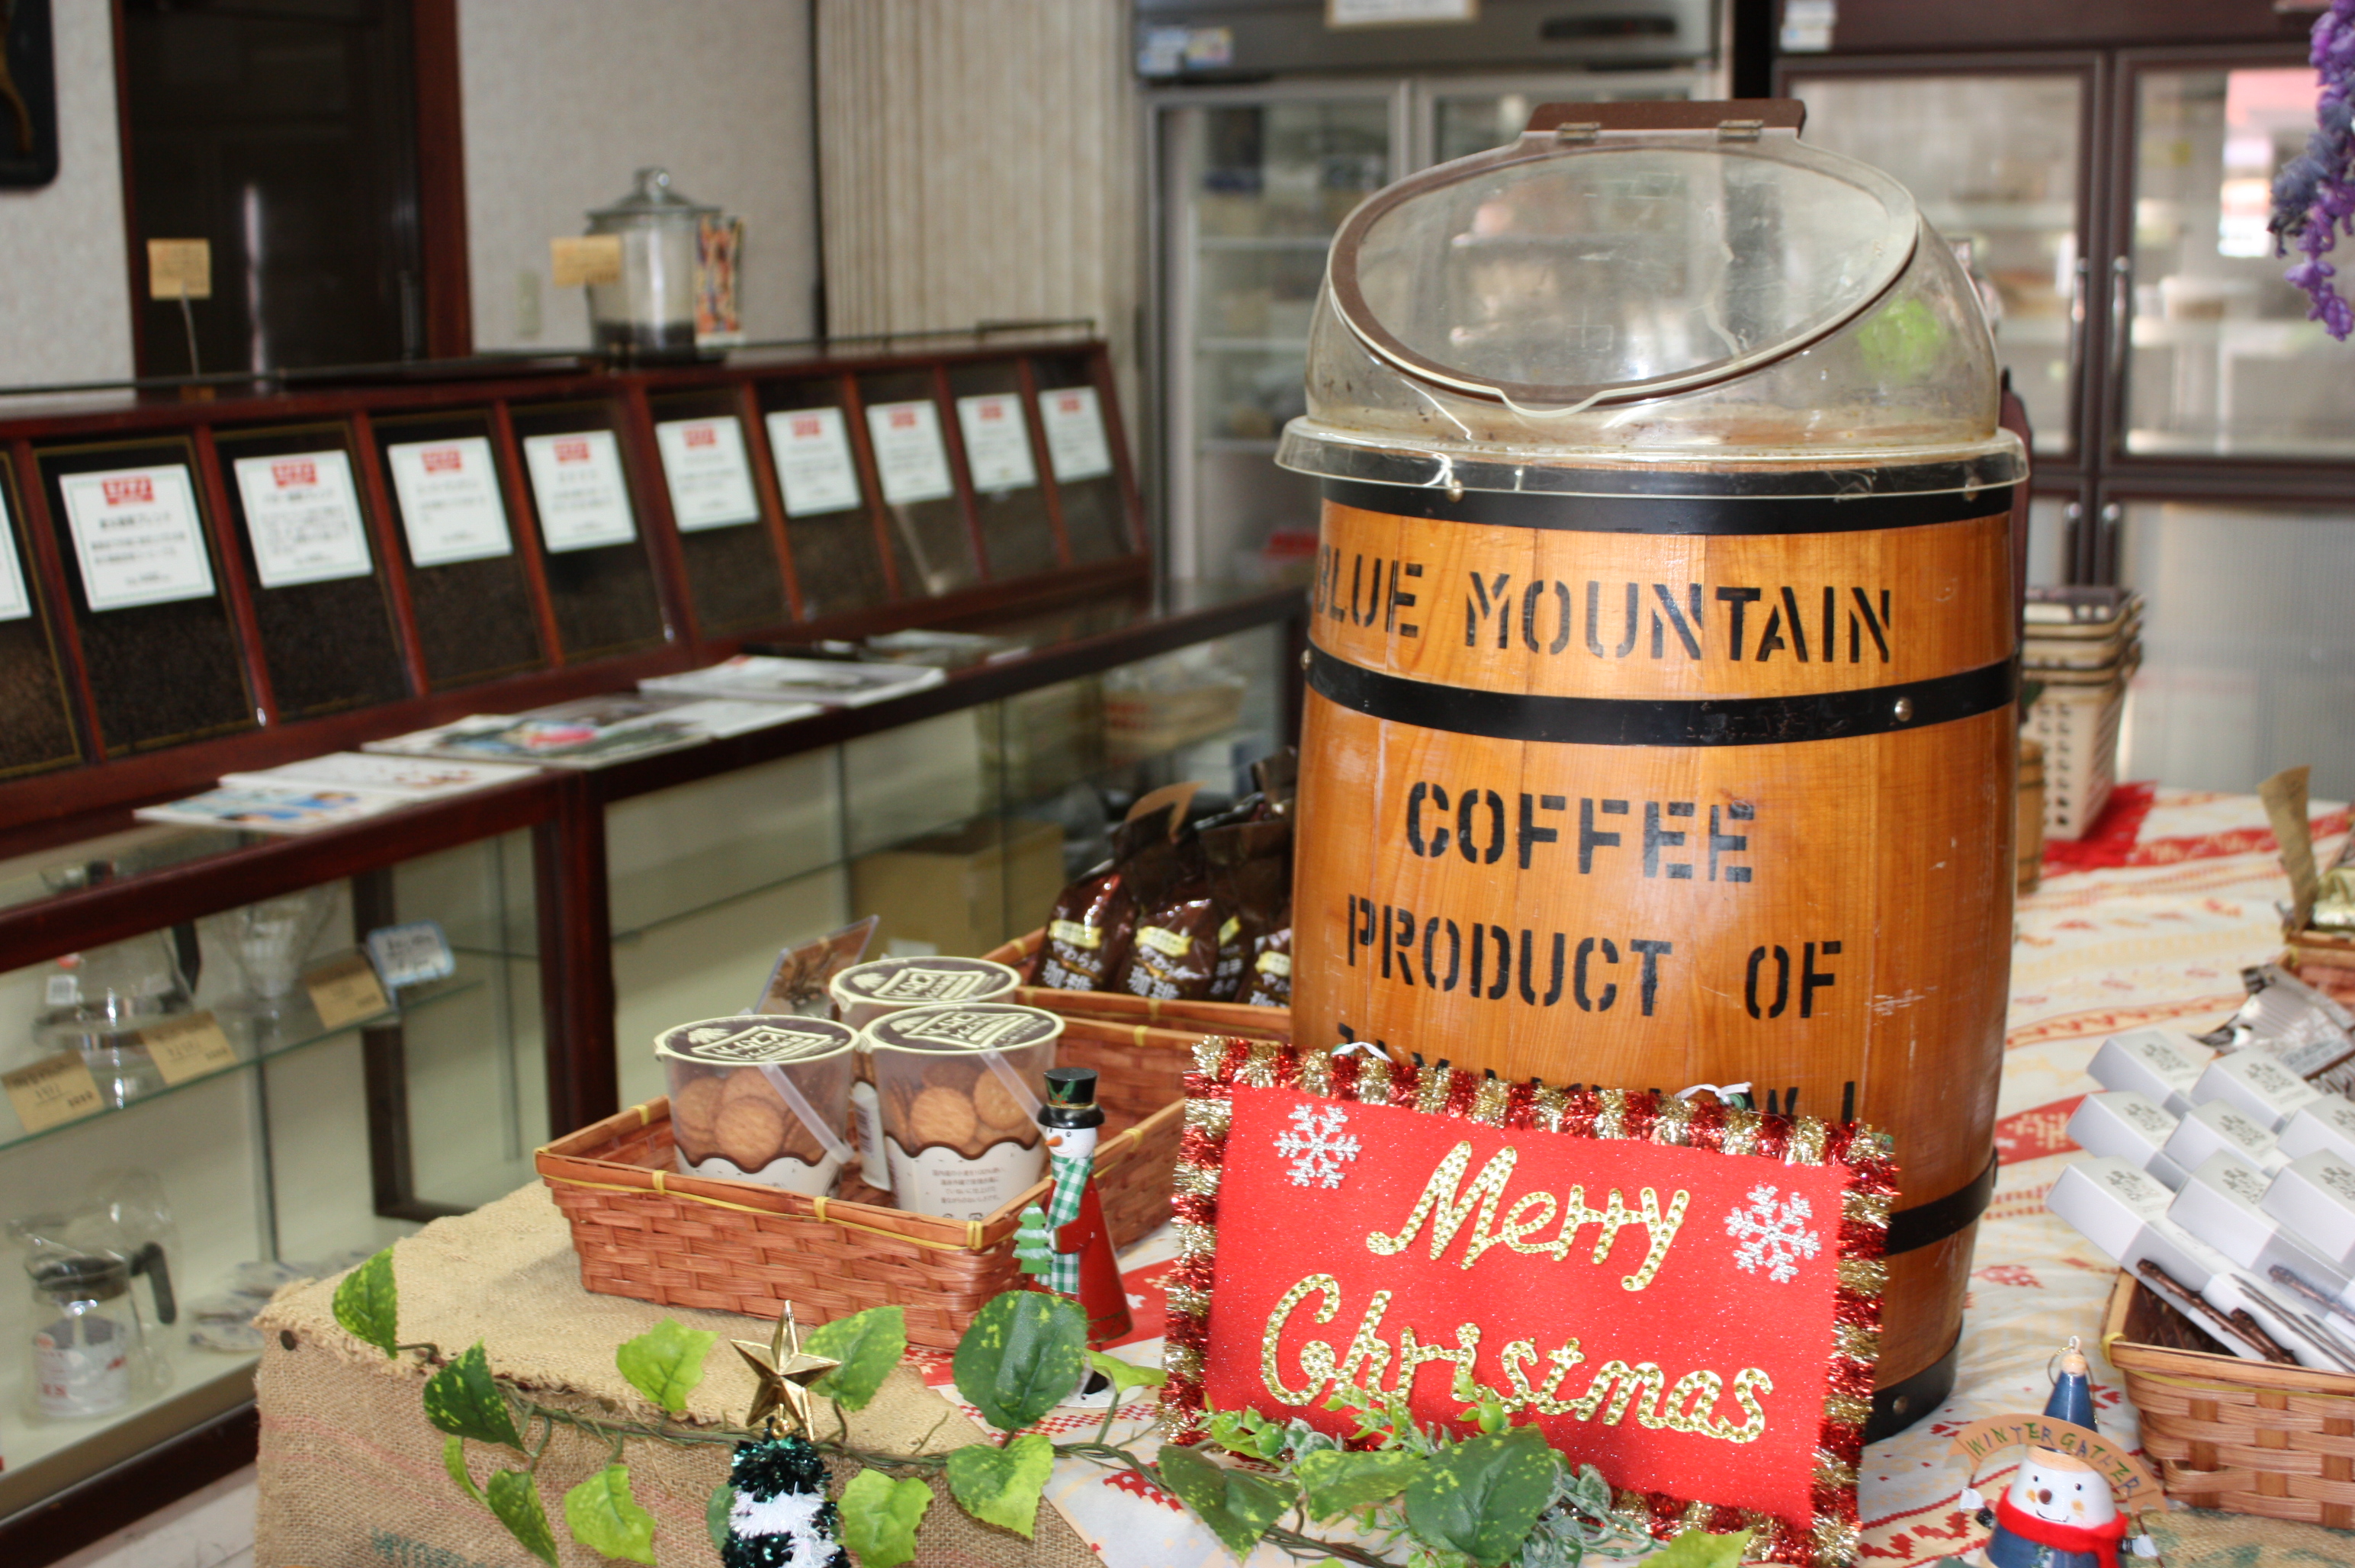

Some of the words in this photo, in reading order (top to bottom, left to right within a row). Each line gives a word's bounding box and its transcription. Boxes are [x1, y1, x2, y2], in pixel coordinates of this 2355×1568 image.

[1319, 544, 1423, 638] BLUE
[1464, 570, 1891, 664] MOUNTAIN
[1406, 780, 1756, 883] COFFEE
[1348, 893, 1673, 1017] PRODUCT
[1744, 940, 1843, 1020] OF
[1366, 1140, 1690, 1292] Merry
[1261, 1274, 1774, 1444] Christmas
[1965, 1422, 2054, 1457] WINTER
